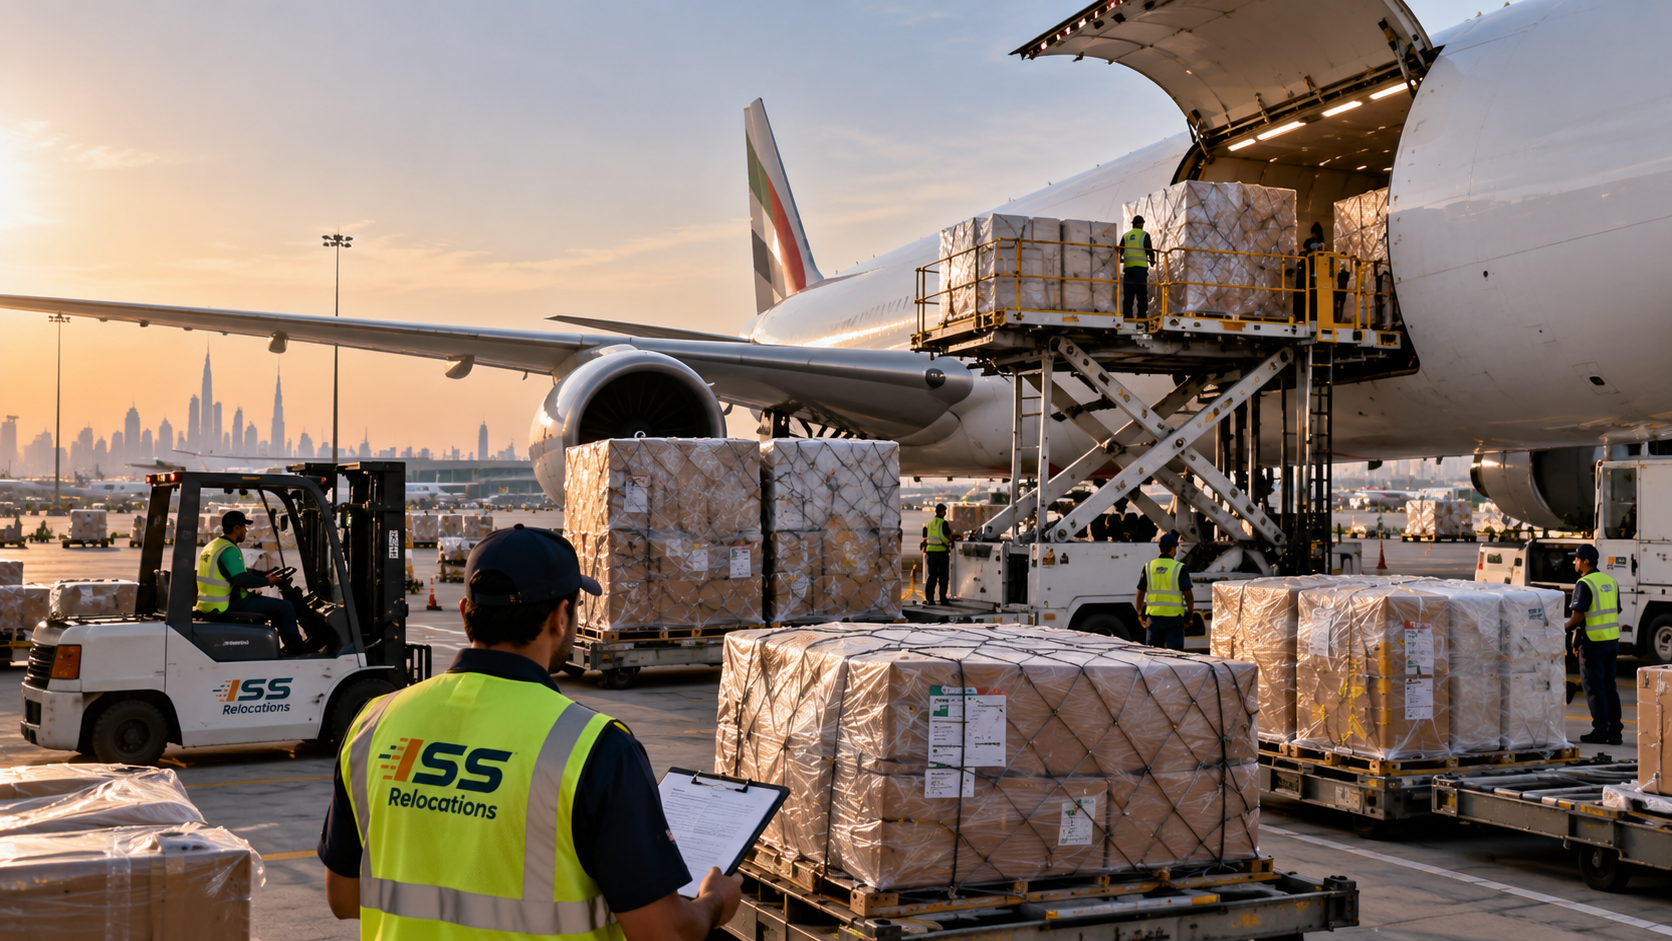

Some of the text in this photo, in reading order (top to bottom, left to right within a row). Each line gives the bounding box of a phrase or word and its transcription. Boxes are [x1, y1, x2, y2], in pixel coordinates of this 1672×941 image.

[225, 678, 294, 702] ISS
[222, 702, 291, 715] Relocations
[393, 738, 513, 794] ISS
[388, 787, 498, 819] Relocations
